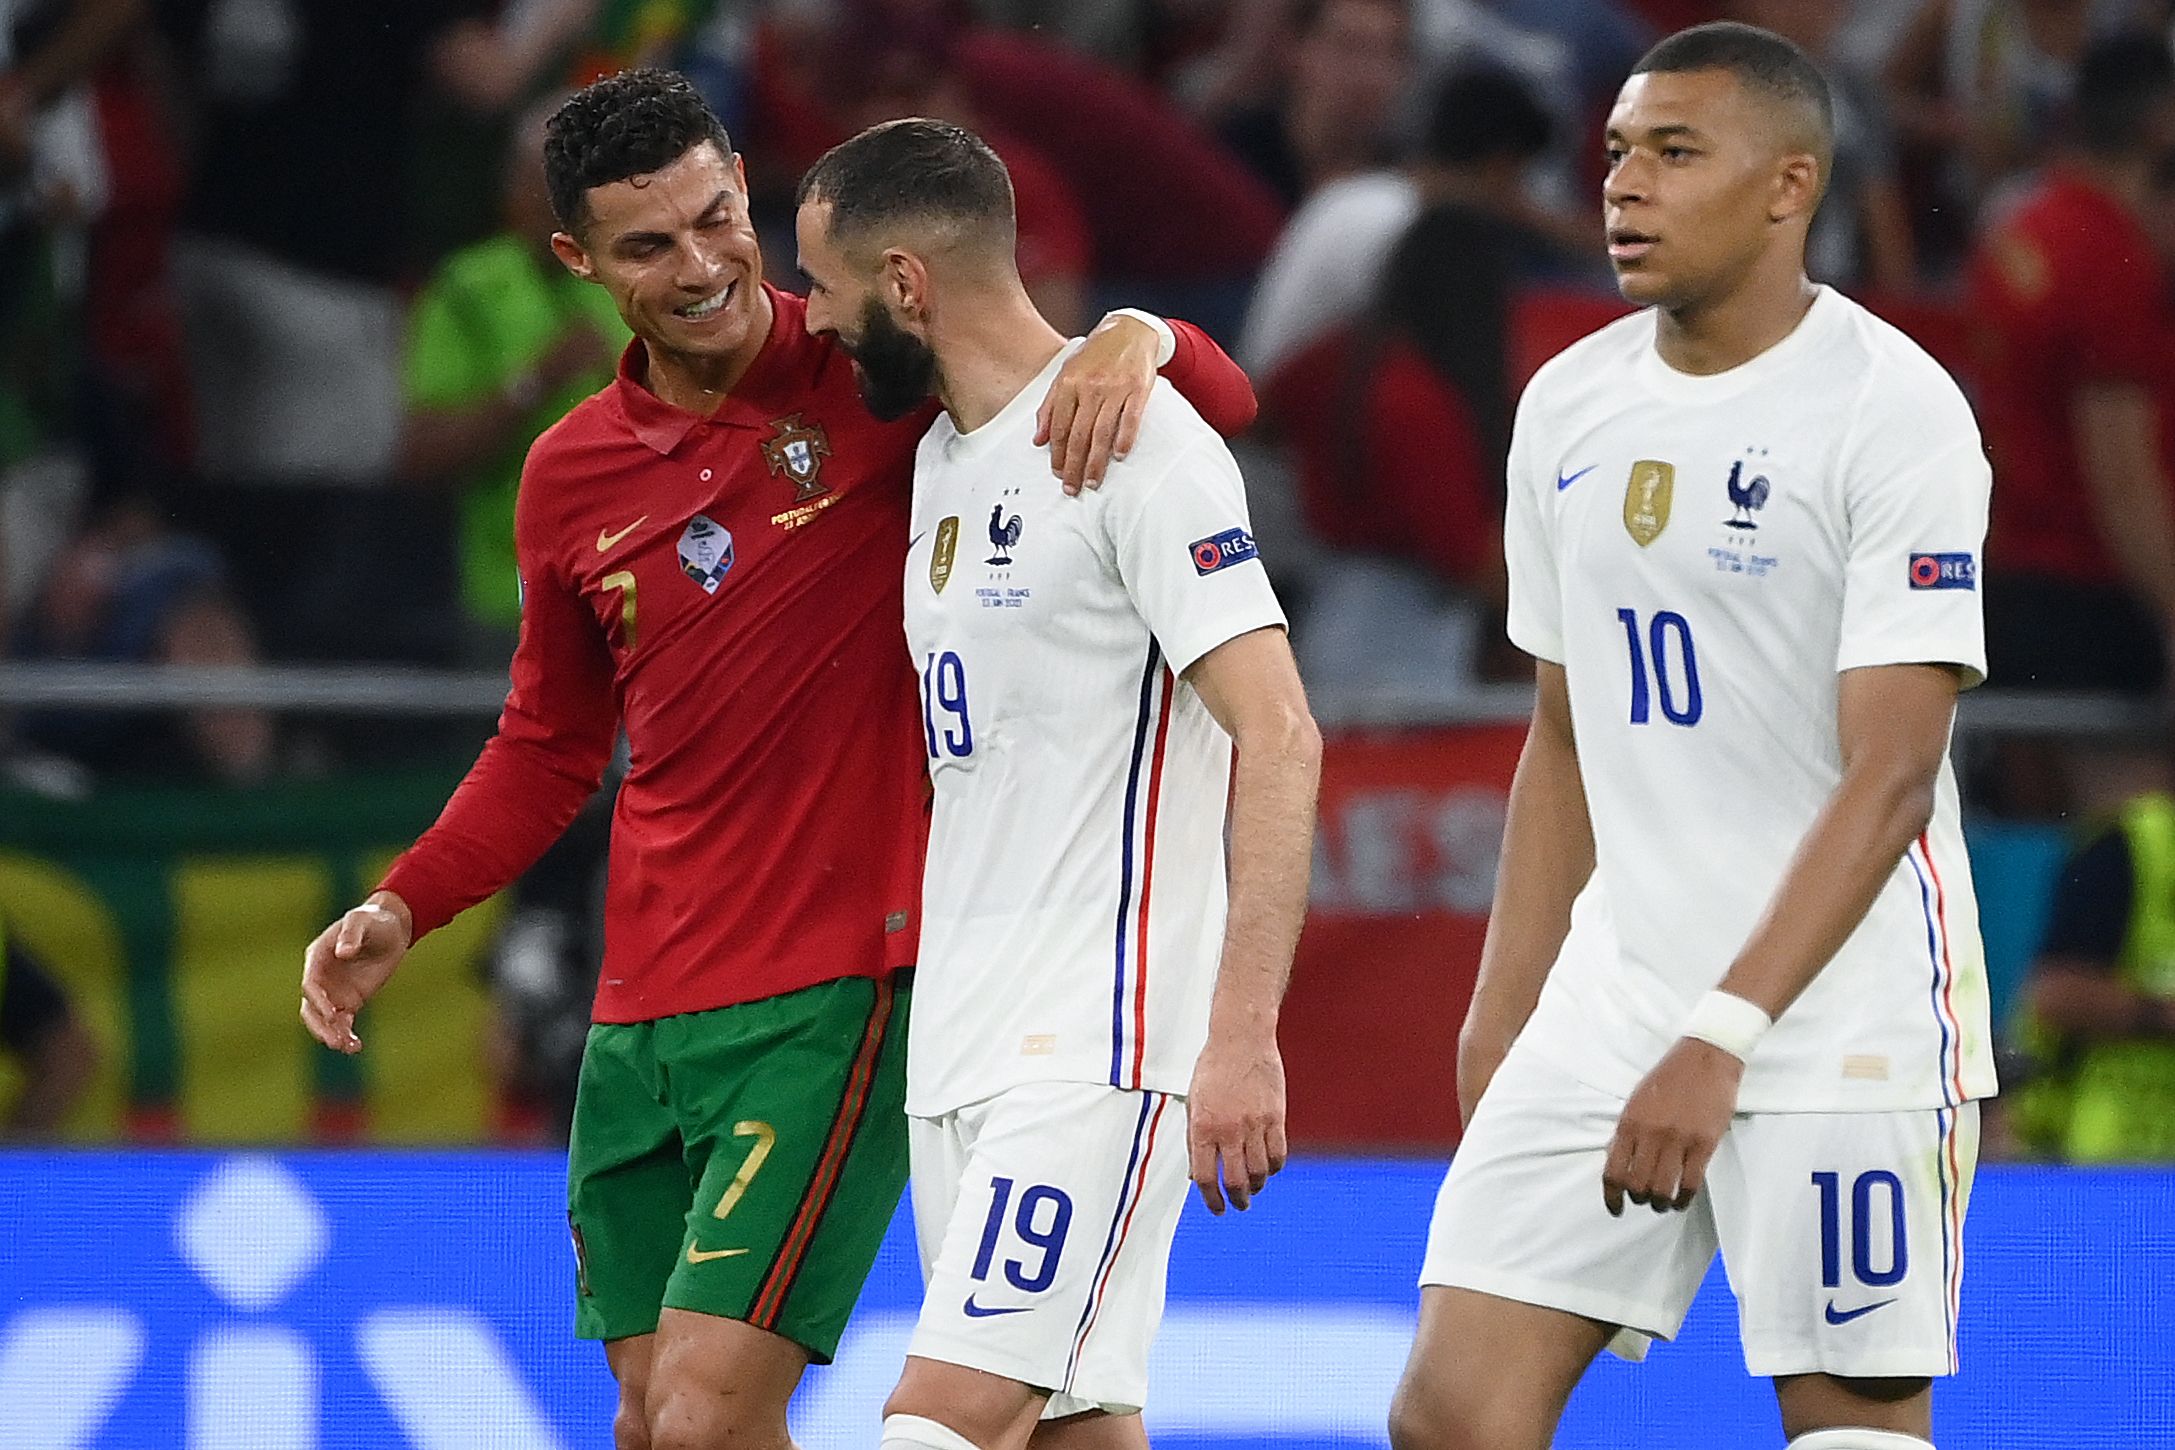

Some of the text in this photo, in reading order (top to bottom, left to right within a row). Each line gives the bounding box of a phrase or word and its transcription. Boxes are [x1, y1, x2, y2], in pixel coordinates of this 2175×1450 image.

[602, 571, 637, 652] 7
[1617, 608, 1702, 727] 10
[925, 651, 974, 758] 19
[714, 1120, 776, 1220] 7
[969, 1175, 1074, 1293] 19
[1811, 1169, 1909, 1288] 10
